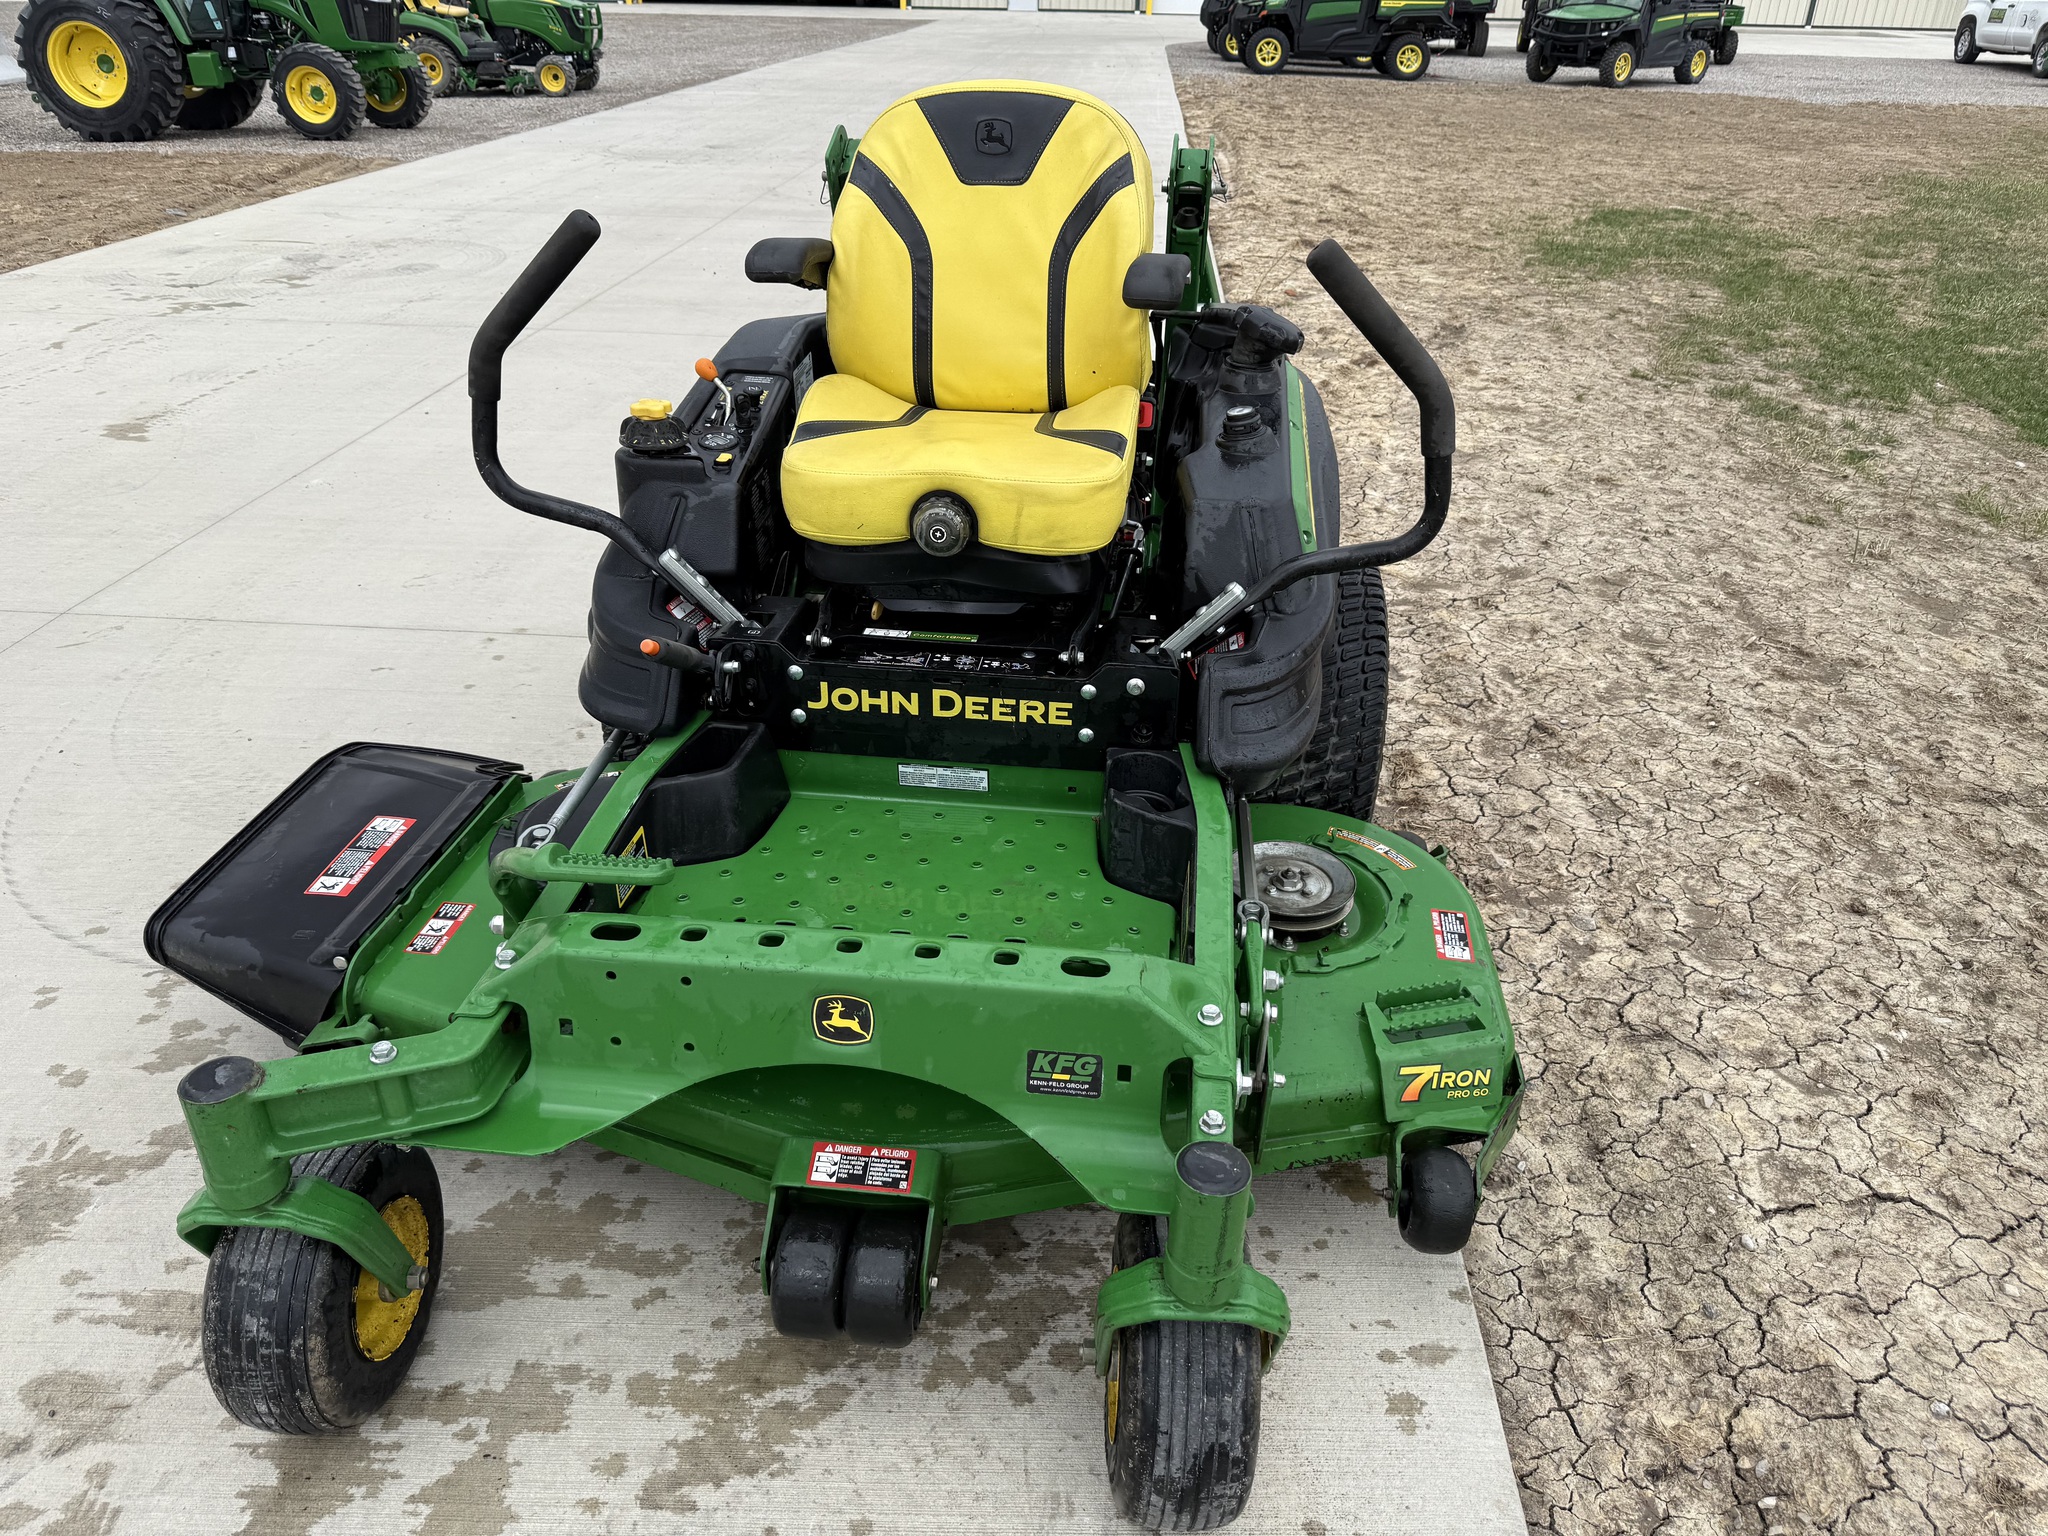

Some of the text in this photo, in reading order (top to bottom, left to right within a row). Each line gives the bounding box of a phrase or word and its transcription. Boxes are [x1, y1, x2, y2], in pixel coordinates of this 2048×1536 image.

[807, 681, 1072, 726] JOHN DEERE
[1032, 1052, 1097, 1076] KFG
[1447, 1088, 1489, 1099] PRO 60
[835, 1145, 861, 1154] DANGER
[881, 1149, 909, 1158] PELIGRO
